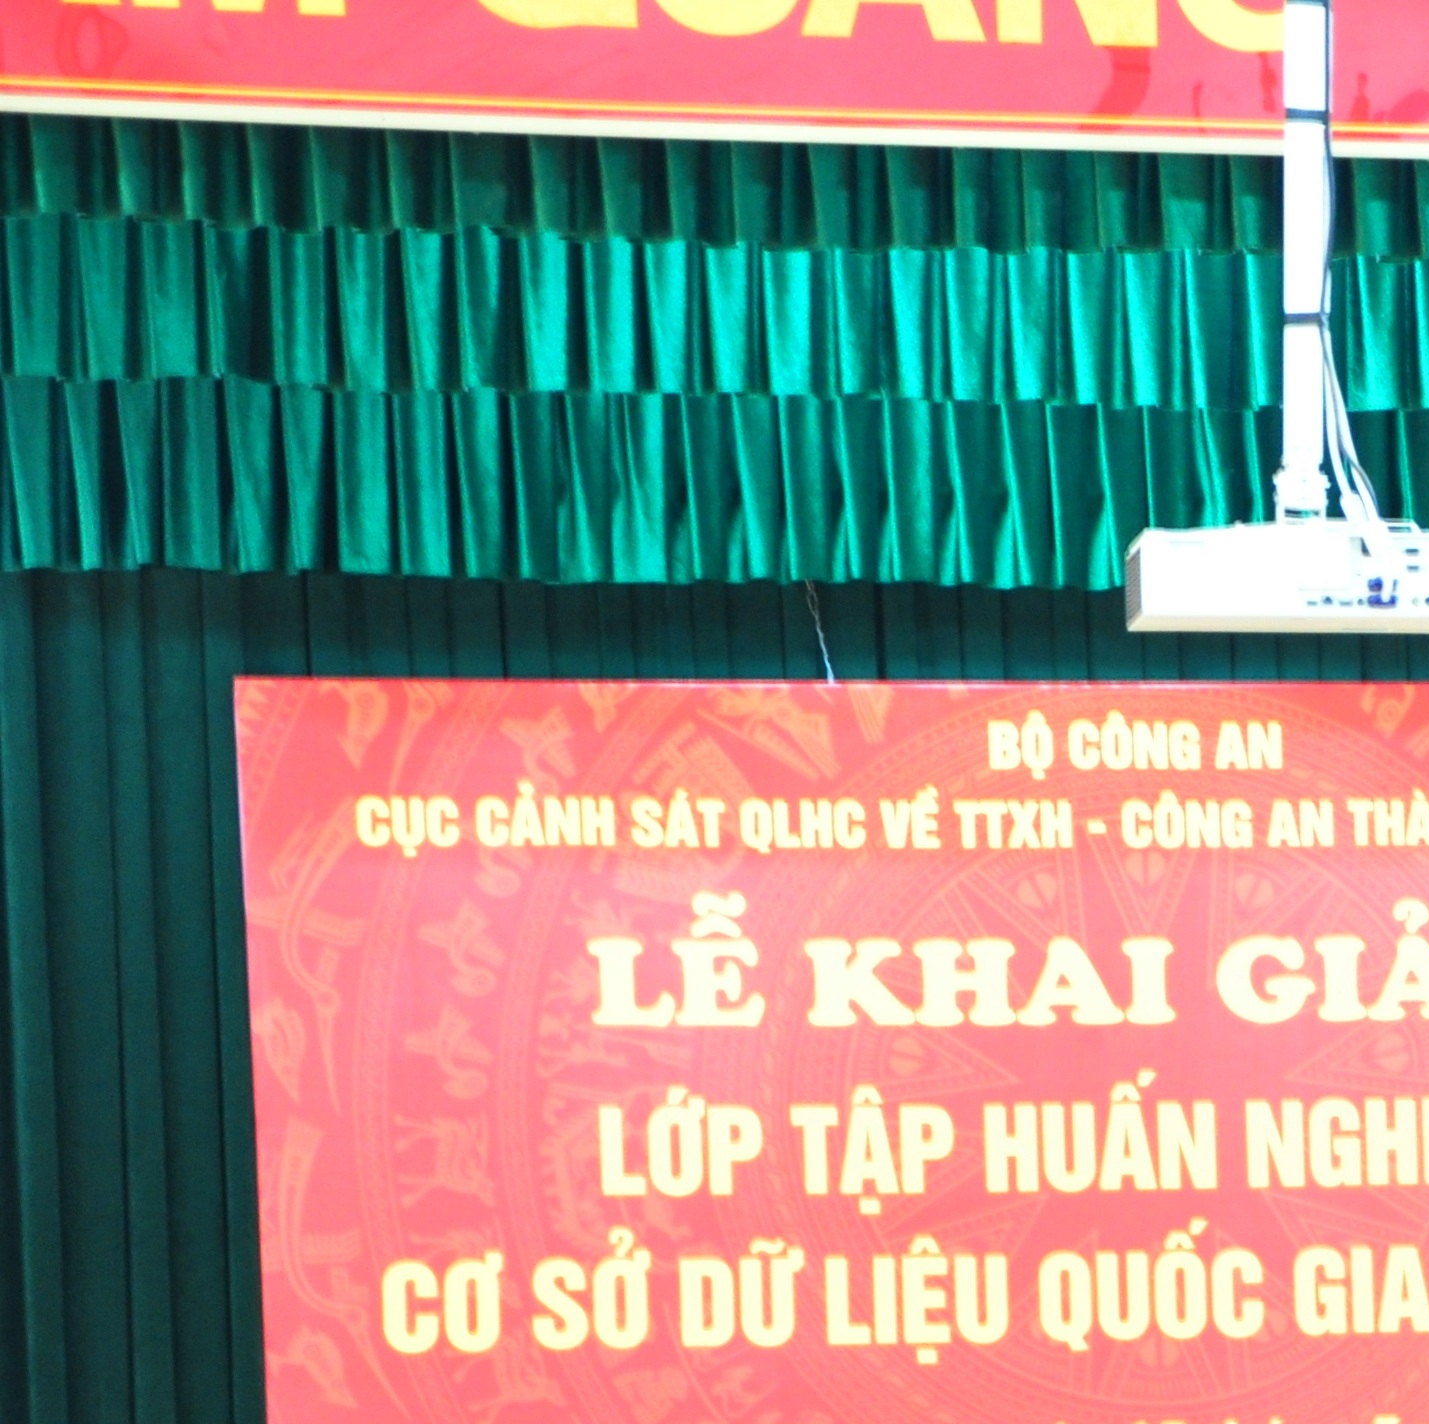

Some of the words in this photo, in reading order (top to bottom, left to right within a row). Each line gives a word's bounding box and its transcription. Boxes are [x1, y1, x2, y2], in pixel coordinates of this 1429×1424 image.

[988, 710, 1054, 780] BỘ
[1068, 710, 1201, 770] CÔNG
[1215, 721, 1283, 769] AN
[356, 797, 460, 857] CỤC
[476, 781, 615, 847] CẢNH
[631, 788, 726, 847] SÁT
[740, 798, 866, 853] QLHC
[880, 785, 940, 849] VỀ
[954, 799, 1073, 849] TTXH
[1121, 790, 1253, 849] CÔNG
[1267, 799, 1334, 847] AN
[587, 890, 765, 1027] LỄ
[804, 937, 1176, 1027] KHAI
[599, 1086, 763, 1196] LỚP
[790, 1085, 954, 1214] TẬP
[984, 1070, 1217, 1192] HUẤN
[383, 1251, 503, 1353] CƠ
[533, 1228, 651, 1349] SỞ
[680, 1239, 804, 1347] DỮ
[825, 1237, 1008, 1364] LIỆU
[1039, 1219, 1264, 1351] QUỐC
